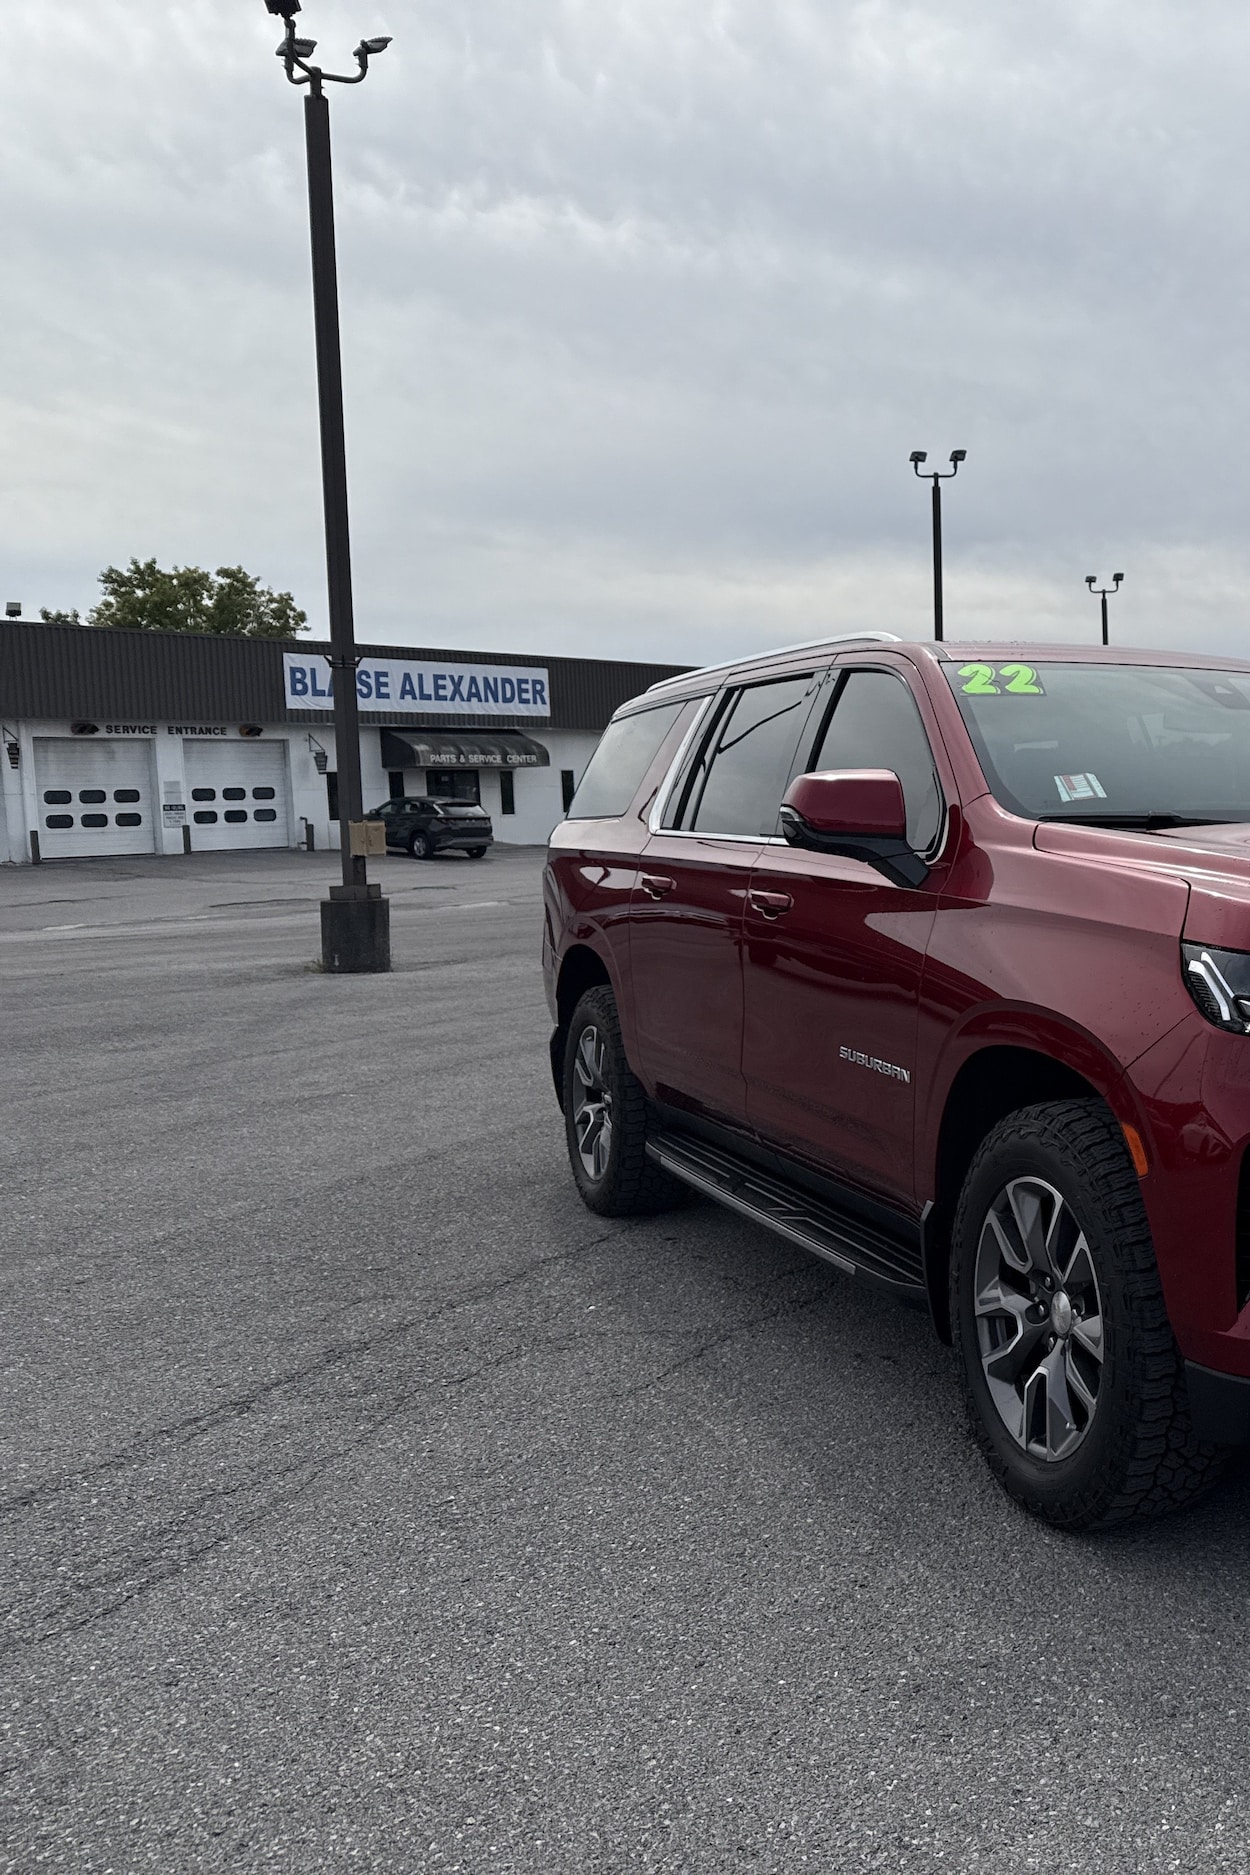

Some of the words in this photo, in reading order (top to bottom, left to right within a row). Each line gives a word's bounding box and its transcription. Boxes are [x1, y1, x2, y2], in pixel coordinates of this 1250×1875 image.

[289, 666, 391, 699] BLSE
[400, 672, 547, 705] ALEXANDER
[957, 663, 1044, 695] 22
[105, 725, 158, 735] SERVICE
[167, 726, 227, 736] ENTRANCE
[430, 754, 457, 763] PARTS
[459, 755, 466, 763] &
[468, 755, 502, 763] SERVICE
[507, 755, 537, 763] CENTER
[839, 1045, 911, 1084] SUBURBAN
